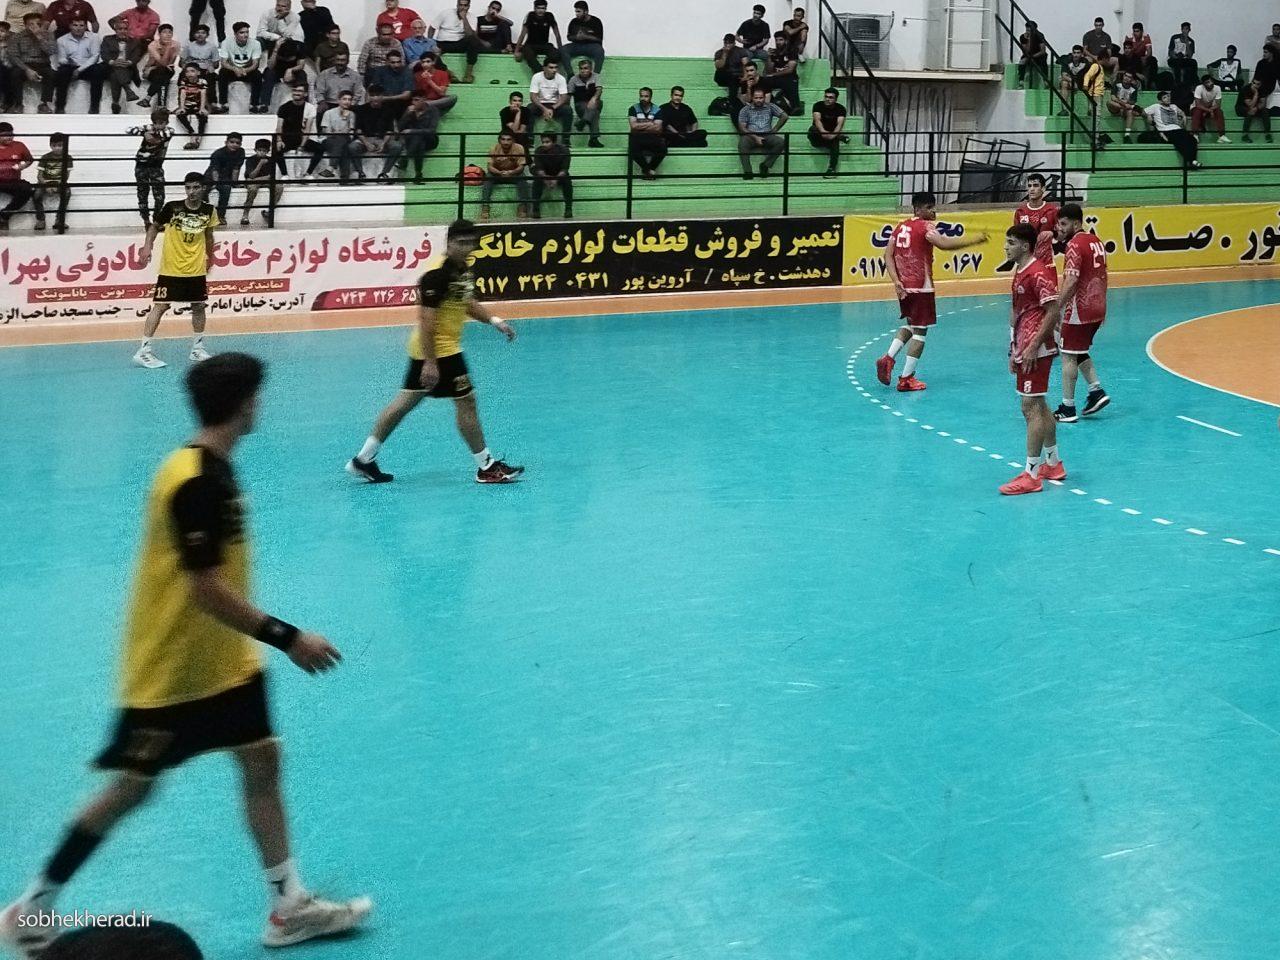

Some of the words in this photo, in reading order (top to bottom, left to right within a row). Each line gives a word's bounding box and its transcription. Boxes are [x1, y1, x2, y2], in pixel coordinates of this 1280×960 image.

[183, 232, 195, 244] 13
[611, 225, 688, 254] قطعات
[694, 223, 763, 259] فروش
[785, 224, 841, 257] تعمیر
[895, 224, 913, 248] 25
[1122, 212, 1214, 254] صدا
[266, 236, 330, 275] لوازم
[338, 232, 433, 270] فروشگاه
[541, 228, 606, 265] لوازم
[767, 235, 781, 257] و
[621, 272, 646, 291] پور
[721, 267, 751, 287] سپاه
[753, 268, 766, 286] خ
[777, 265, 831, 281] دهدشت
[156, 286, 168, 299] 13
[268, 292, 306, 311] آدرس:
[20, 305, 58, 322] صاحب
[60, 305, 94, 320] مسجد
[95, 304, 122, 319] جنب
[210, 297, 232, 314] امام
[233, 295, 267, 313] خیابان
